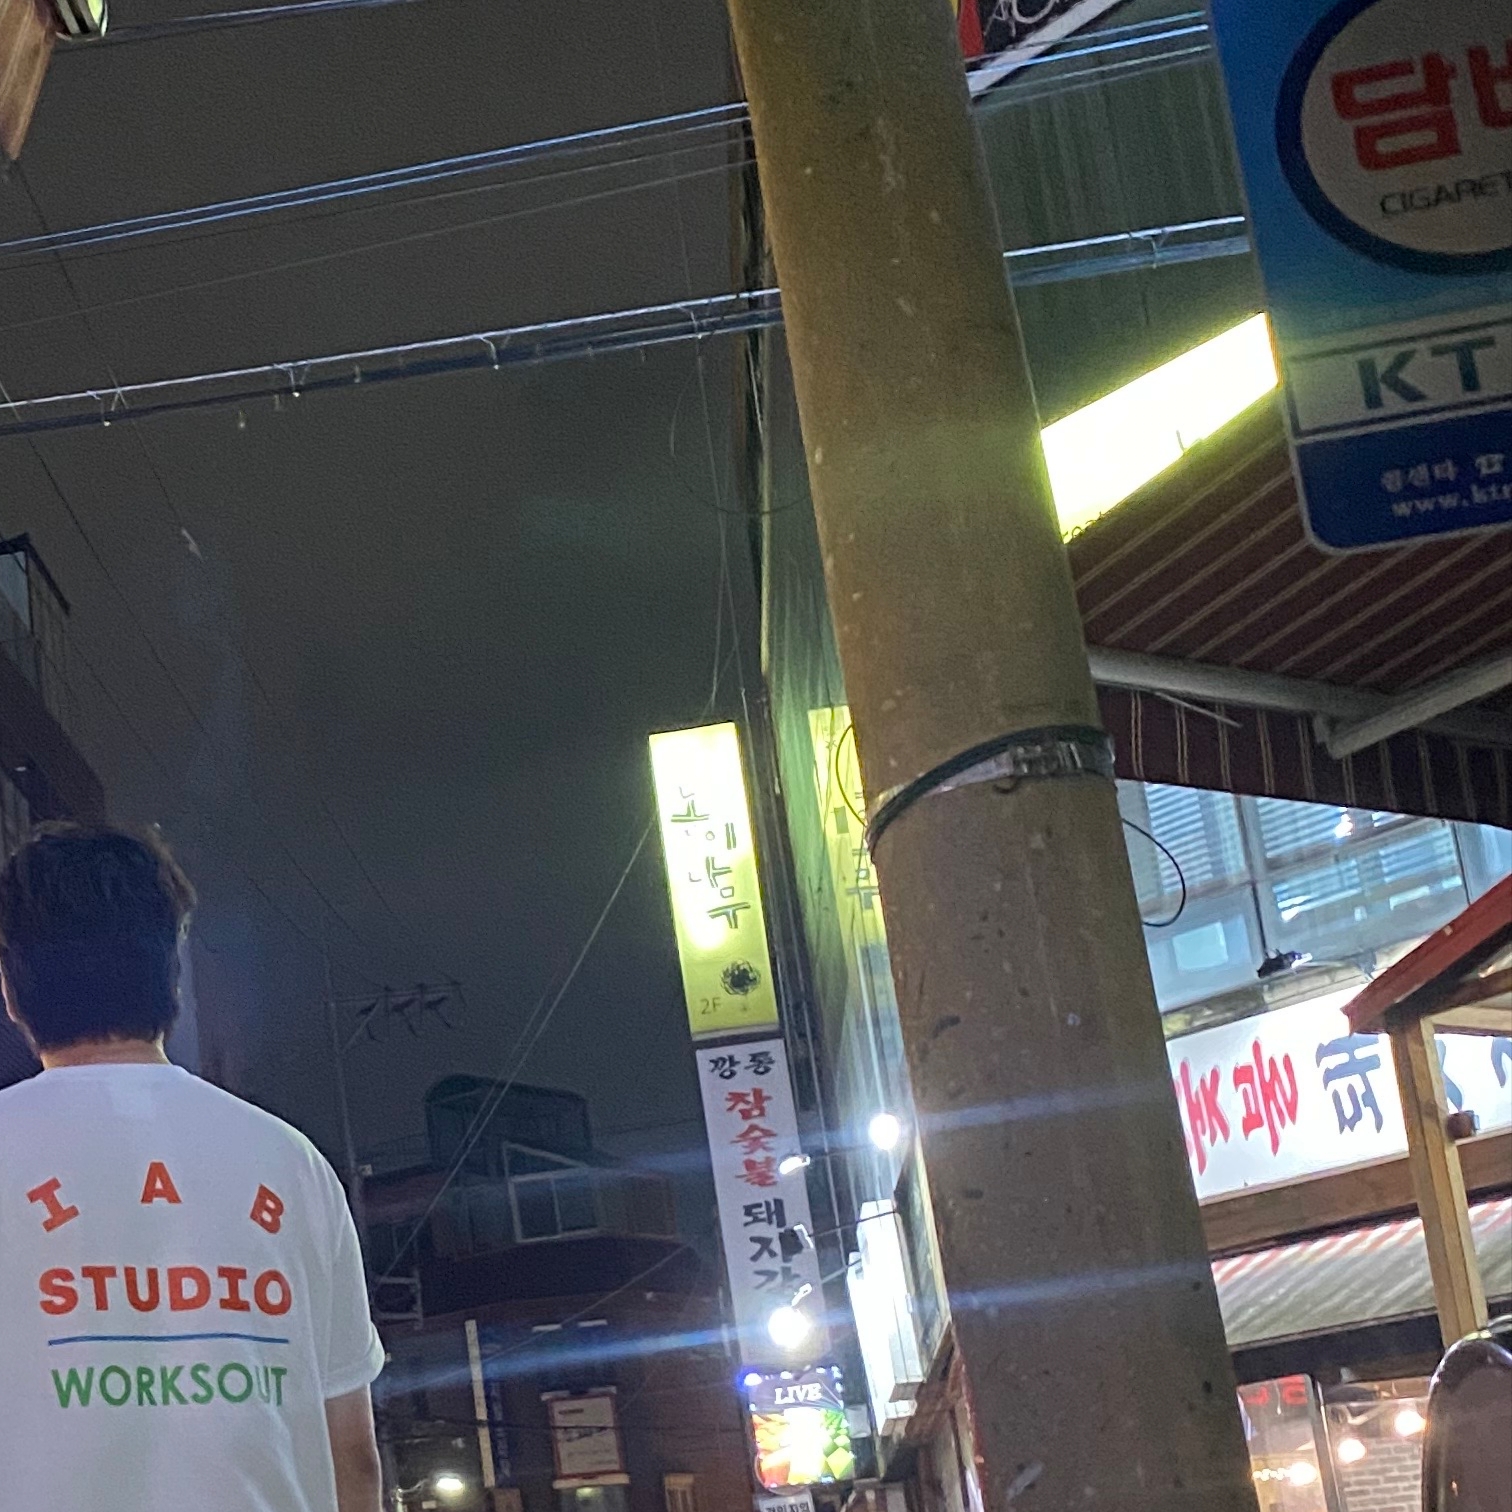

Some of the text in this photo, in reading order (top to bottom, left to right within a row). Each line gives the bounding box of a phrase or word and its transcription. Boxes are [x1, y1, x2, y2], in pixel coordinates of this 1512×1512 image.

[700, 997, 721, 1015] 2F
[39, 1265, 292, 1316] STUDIO
[52, 1361, 288, 1409] WORKSOUT
[774, 1383, 823, 1405] LIVE
